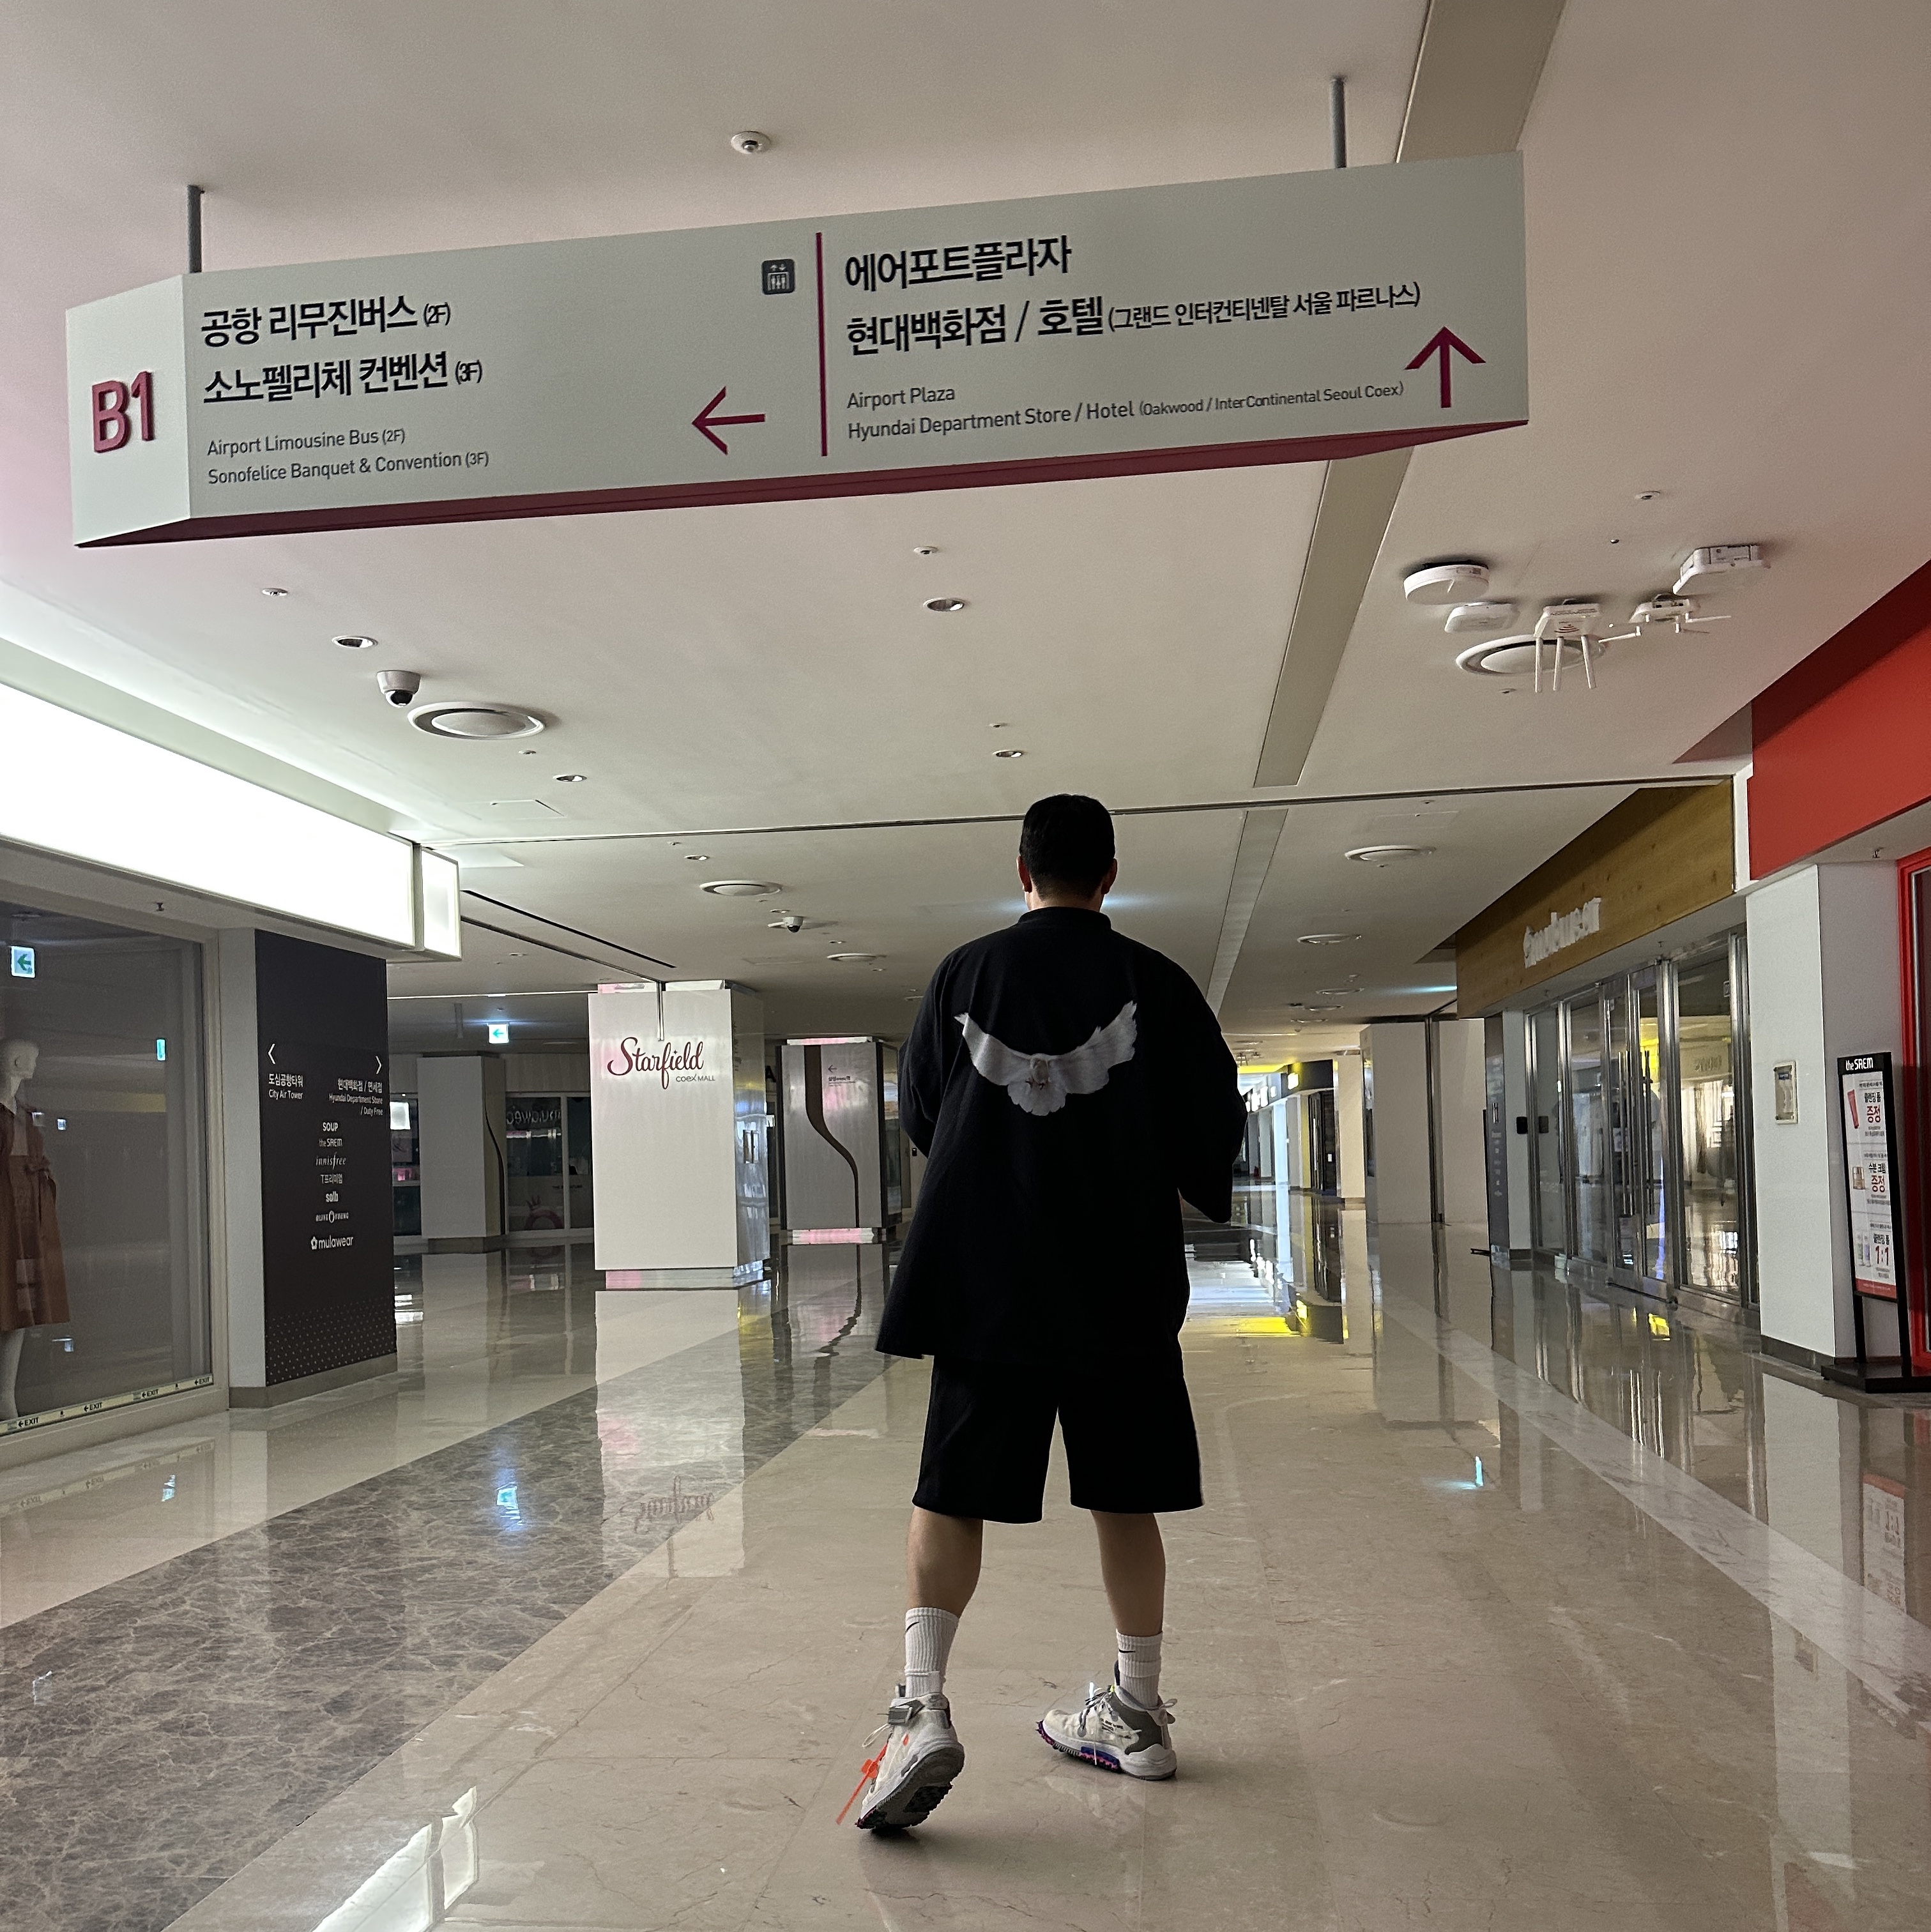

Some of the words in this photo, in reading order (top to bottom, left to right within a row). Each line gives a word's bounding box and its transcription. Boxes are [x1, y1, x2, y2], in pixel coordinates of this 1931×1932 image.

[844, 234, 1072, 292] 에어포트플라자
[201, 307, 262, 347] 공항
[270, 295, 418, 340] 리무진버스
[424, 302, 450, 326] (2F)
[846, 304, 1007, 356] 현대백화점
[1014, 301, 1030, 342] /
[1037, 296, 1104, 336] 호텔
[1108, 304, 1171, 331] (그랜드
[1175, 294, 1289, 327] 인터컨티넨탈
[1293, 290, 1332, 316] 서울
[1336, 281, 1421, 310] 파르나스)
[203, 358, 351, 404] 소노펠리체
[359, 351, 448, 395] 컨벤션
[455, 360, 483, 384] (3F)
[846, 388, 906, 411] Airport
[910, 386, 956, 405] Plaza
[92, 370, 156, 453] B1
[848, 417, 916, 441] Hyundai
[919, 412, 1021, 438] Department
[1025, 406, 1071, 425] Store
[1074, 402, 1083, 422] /
[1086, 401, 1135, 420] Hotel
[1139, 397, 1204, 417] (Oakwood
[1214, 389, 1321, 411] InterContinental
[1324, 386, 1362, 402] Seoul
[1365, 381, 1404, 400] Coex)
[207, 437, 262, 458] Airport
[265, 432, 346, 453] Limousine
[349, 429, 379, 445] Bus
[382, 427, 406, 446] (2F)
[208, 464, 287, 485] Sonofelice
[291, 460, 356, 482] Banquet
[359, 458, 372, 473] &
[376, 453, 462, 473] Convention
[465, 451, 489, 468] (3F)
[607, 1037, 704, 1090] Starfield
[268, 1073, 303, 1088] 도심공항타워
[337, 1077, 363, 1092] 현대백화점
[268, 1088, 279, 1100] City
[288, 1090, 303, 1099] Tower
[329, 1093, 347, 1104] Hyundai
[347, 1093, 371, 1104] Department
[372, 1096, 383, 1105] Store
[364, 1107, 373, 1117] Duty
[374, 1107, 383, 1116] Free
[322, 1122, 339, 1132] SOUP
[316, 1152, 347, 1170] innisfree
[318, 1235, 354, 1250] mulawear
[1875, 1245, 1889, 1266] 1:1
[199, 1376, 210, 1385] EXIT
[147, 1388, 159, 1397] EXIT
[89, 1402, 103, 1411] EXIT
[24, 1417, 39, 1426] EXIT
